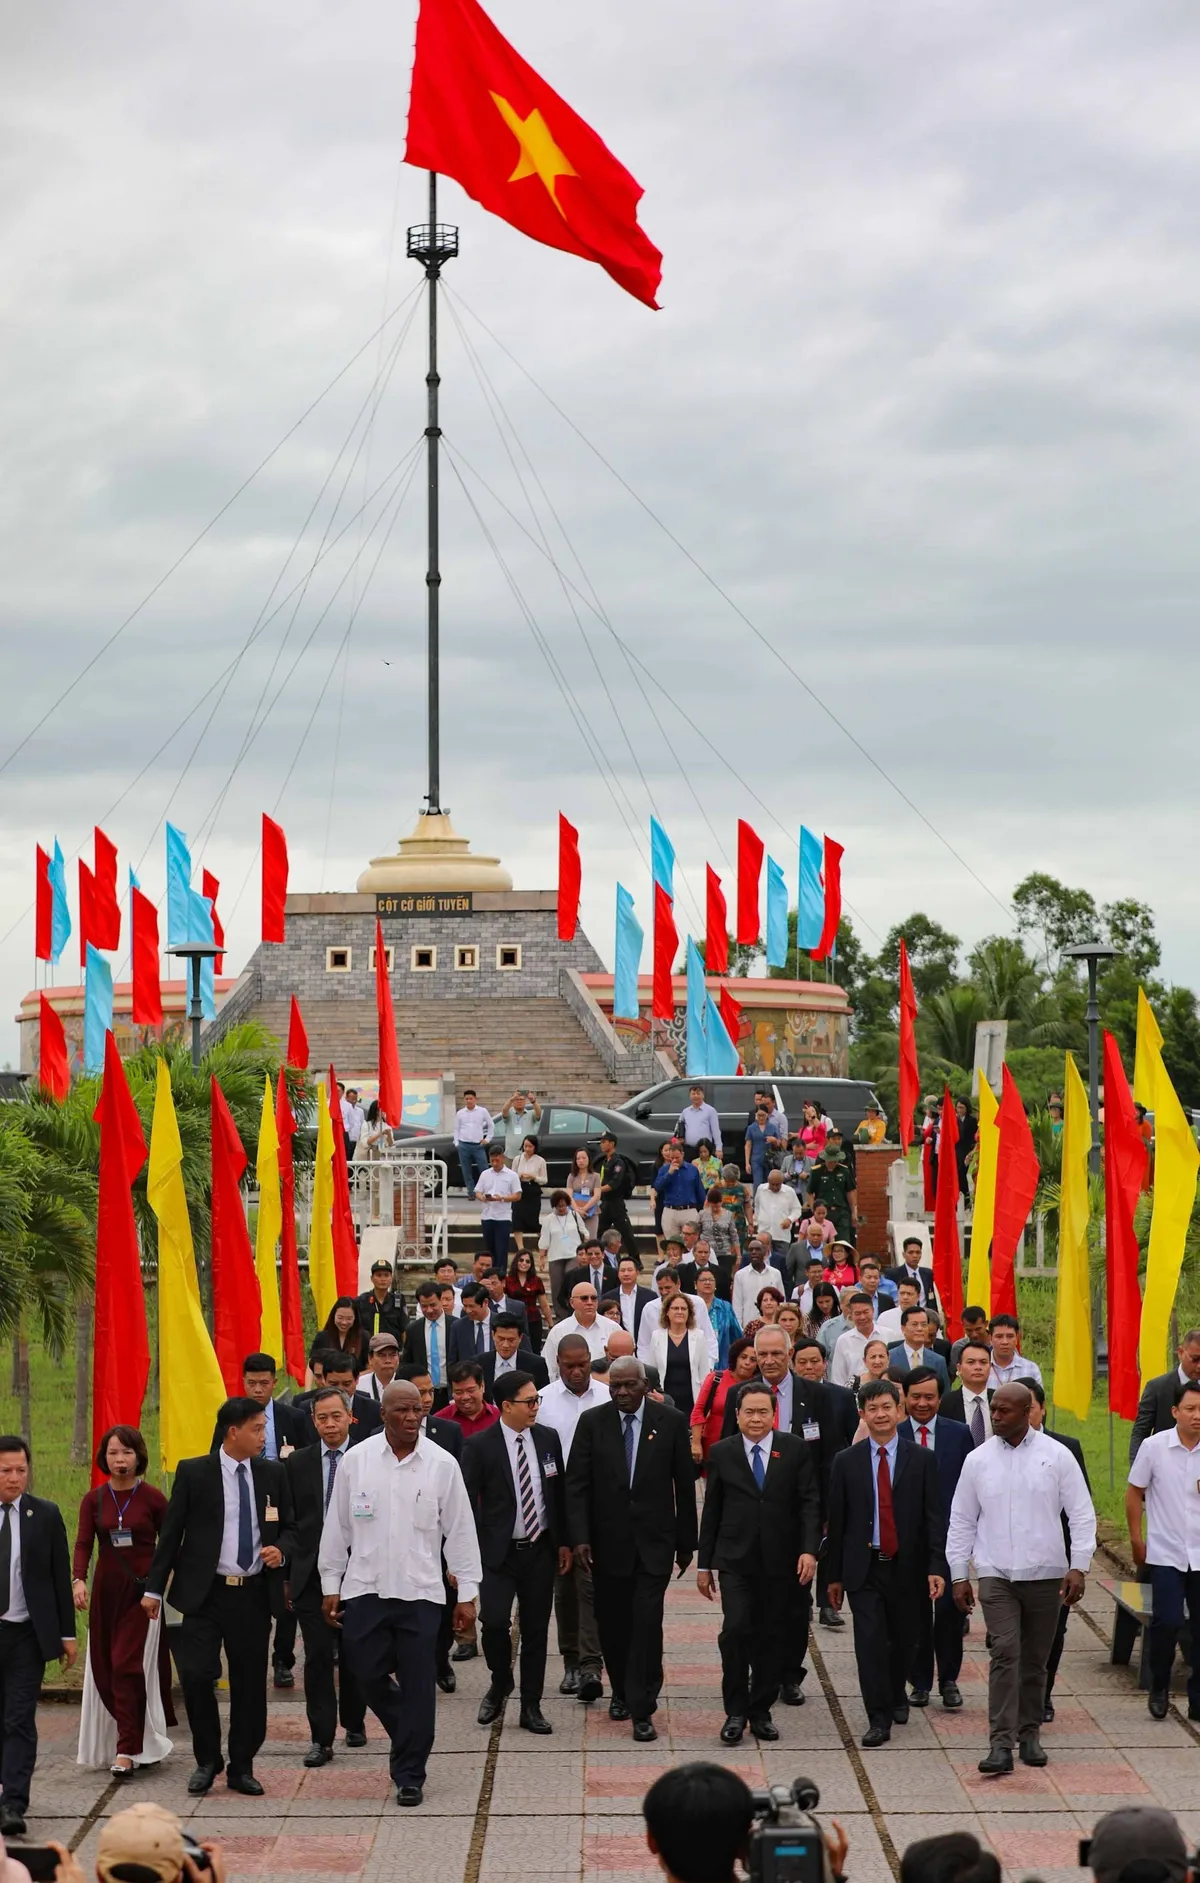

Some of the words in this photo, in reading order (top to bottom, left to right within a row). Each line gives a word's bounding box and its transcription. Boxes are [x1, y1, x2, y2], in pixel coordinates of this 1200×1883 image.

[378, 896, 398, 914] CỘT
[401, 896, 414, 911] CỜ
[438, 895, 469, 911] TUYẾN
